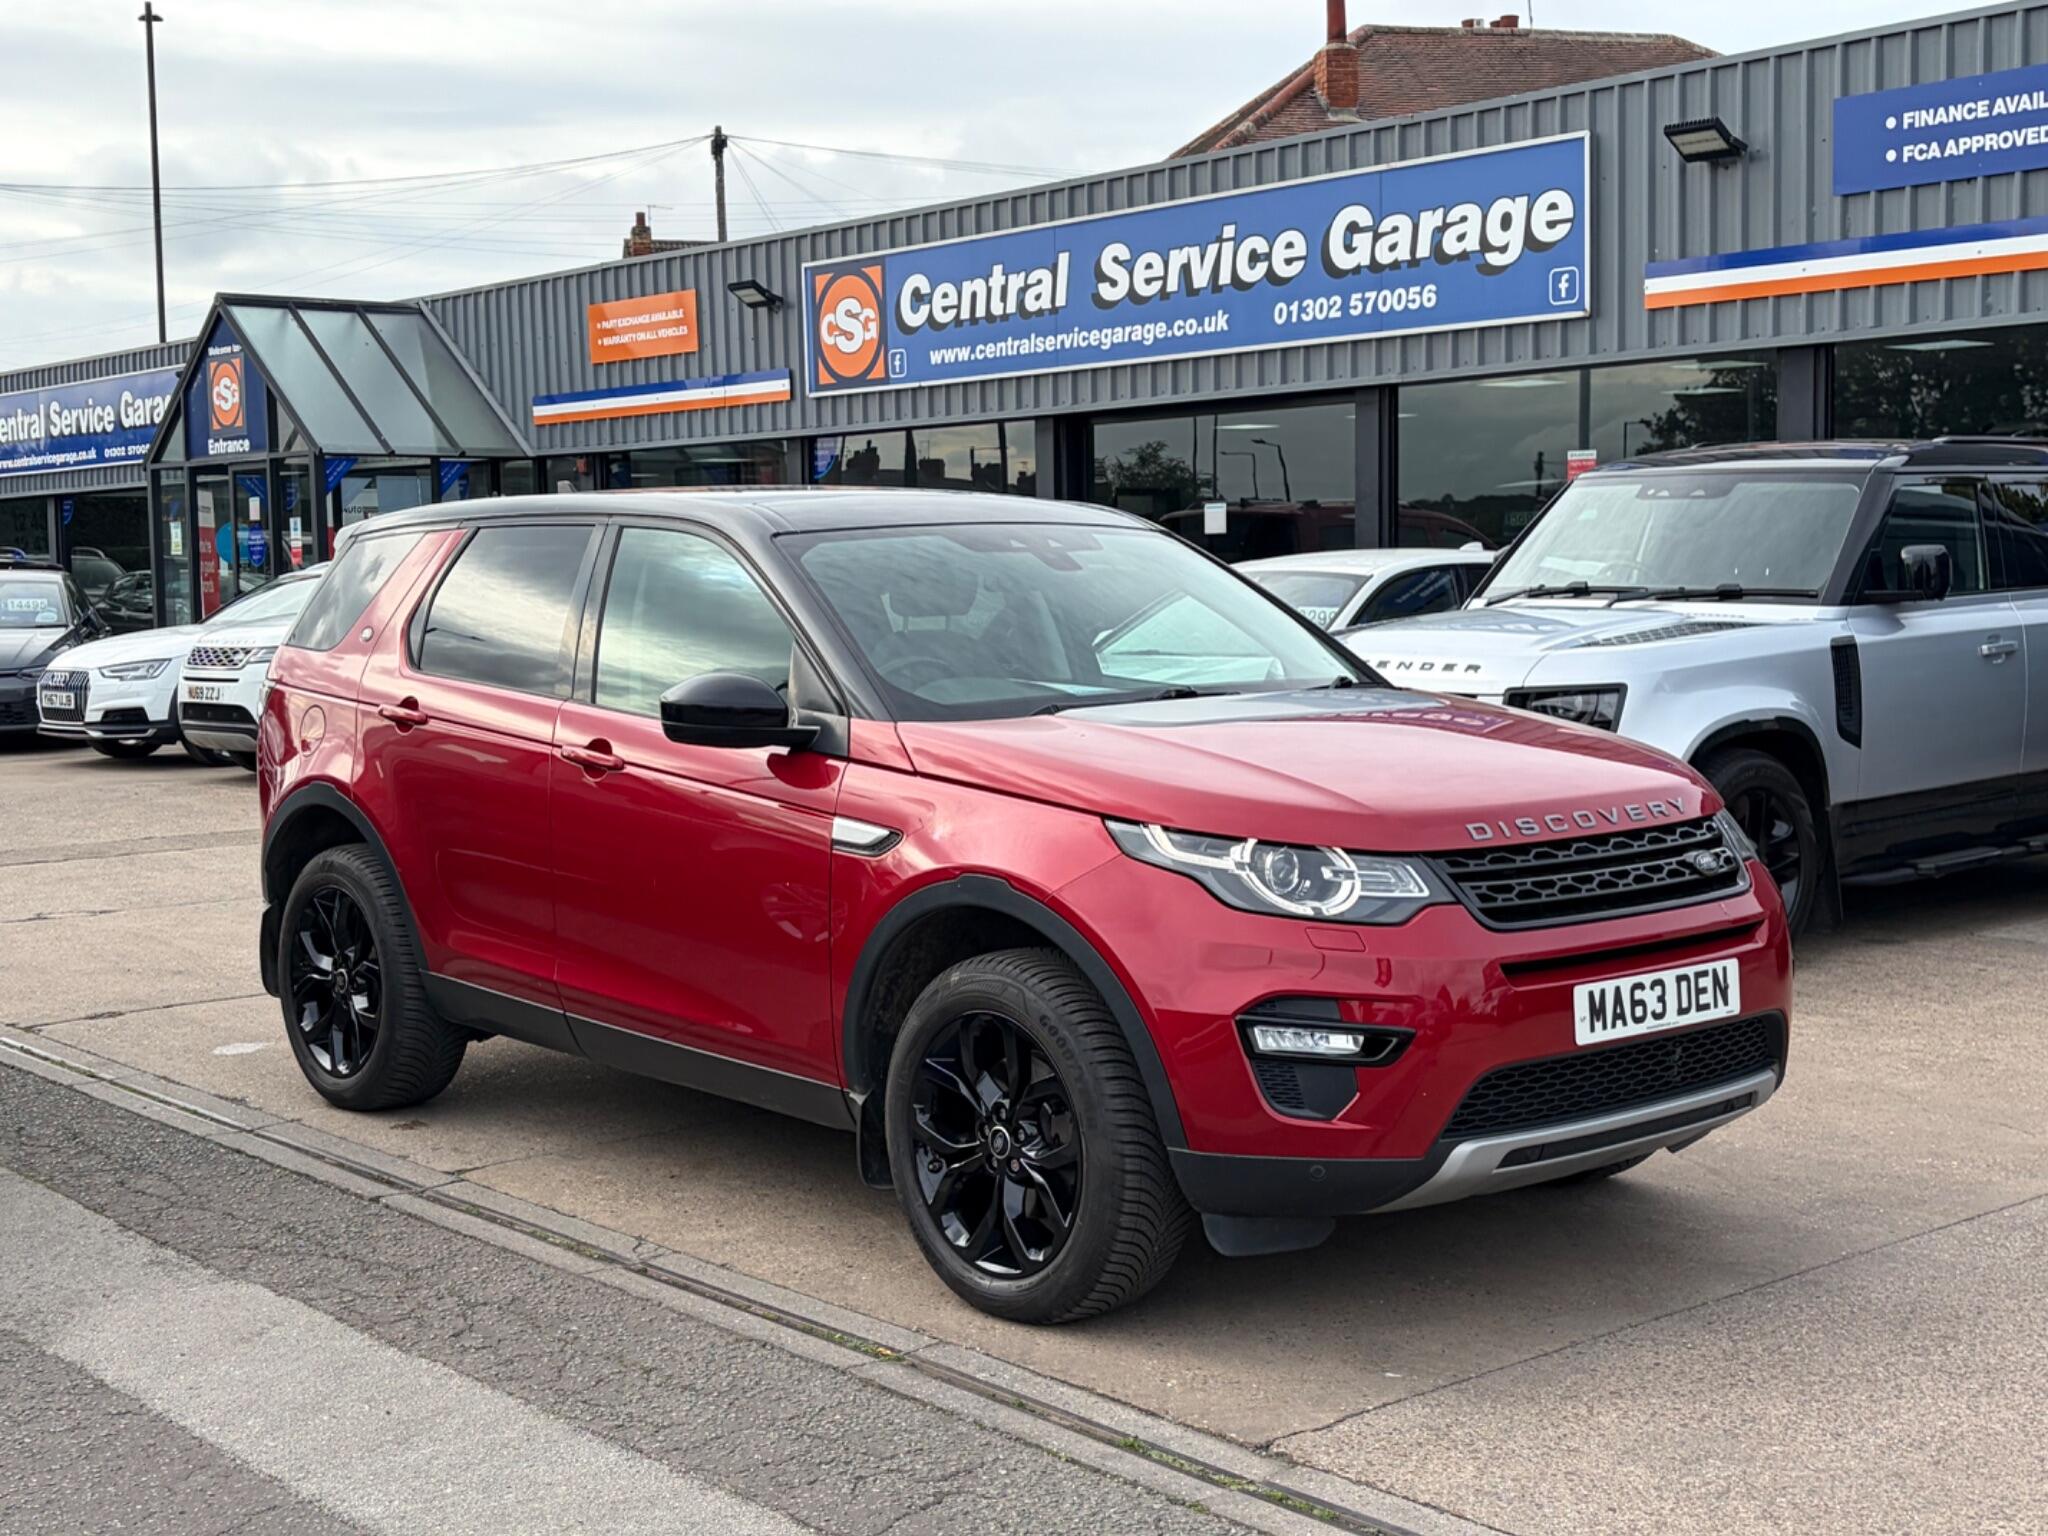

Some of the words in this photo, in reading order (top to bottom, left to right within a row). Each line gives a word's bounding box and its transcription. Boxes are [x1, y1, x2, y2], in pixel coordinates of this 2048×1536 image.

[1903, 100, 1990, 129] FINANCE
[1903, 141, 1941, 163] FCA
[1944, 125, 2048, 158] APPROVED
[899, 250, 1070, 328] Central
[1096, 223, 1308, 302] Service
[1328, 188, 1575, 267] Garage
[820, 297, 878, 354] CSG
[930, 309, 1230, 365] www.centralservicegarage.co.uk
[1273, 295, 1342, 325] 01302
[1348, 284, 1437, 316] 570056
[50, 398, 115, 436] Service
[208, 438, 250, 455] Entrance
[1366, 659, 1482, 674] ENDER
[1465, 797, 1686, 841] DISCOVERY
[1588, 978, 1668, 1034] MA63
[1675, 965, 1730, 1017] DEN
